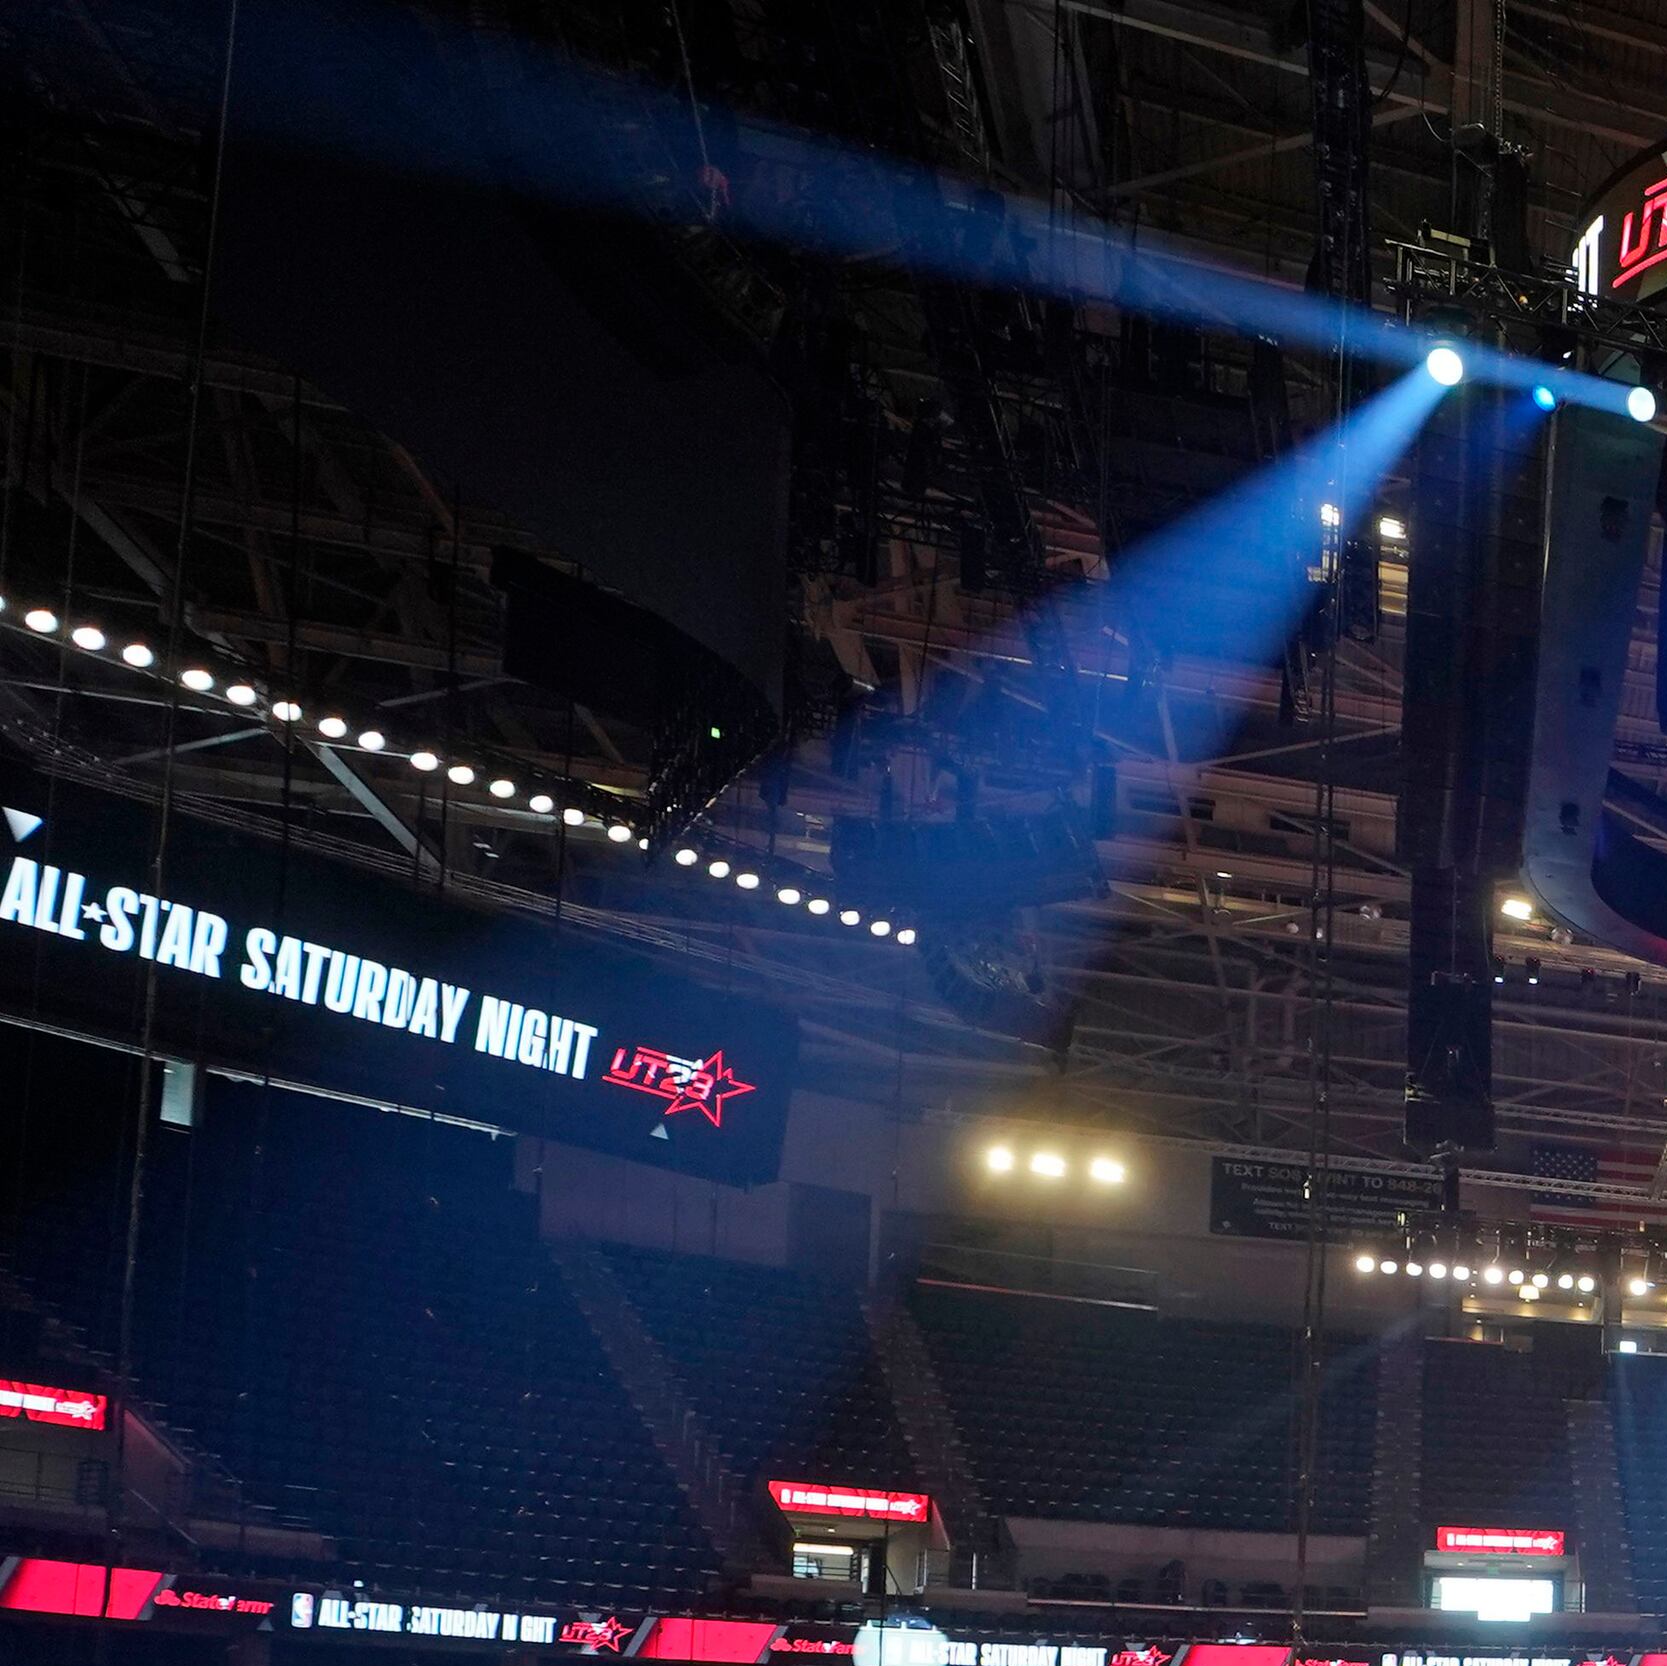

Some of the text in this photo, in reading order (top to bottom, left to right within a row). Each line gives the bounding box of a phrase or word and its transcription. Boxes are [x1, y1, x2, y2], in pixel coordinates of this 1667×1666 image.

[240, 927, 470, 1043] SATURDAY
[475, 995, 598, 1080] NIGHT
[502, 1613, 557, 1644] NGHT
